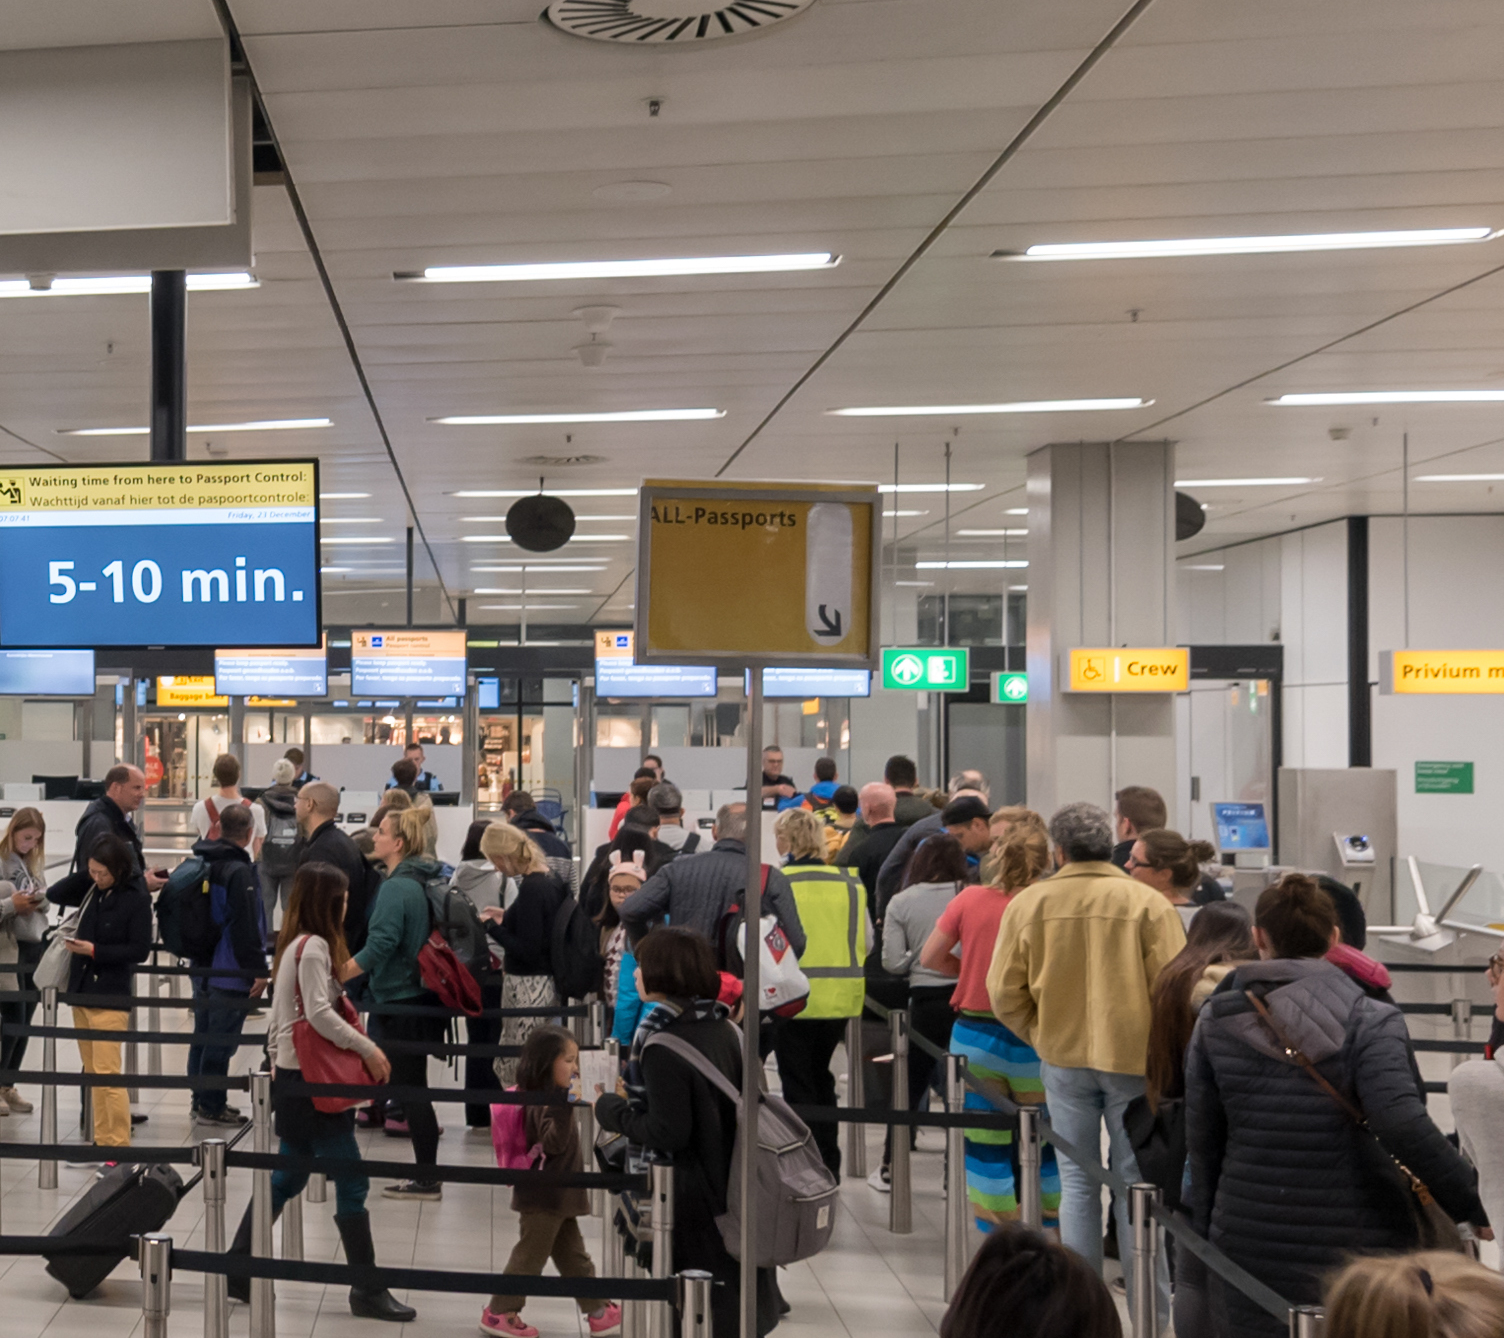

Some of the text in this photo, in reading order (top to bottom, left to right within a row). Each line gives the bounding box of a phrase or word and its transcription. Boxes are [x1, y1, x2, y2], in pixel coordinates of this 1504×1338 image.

[30, 471, 307, 488] Waiting time from here to Passport Control:
[30, 492, 310, 508] Wachttijd vanaf hier tot de paspoortcontrole:
[227, 511, 255, 520] Friday,
[269, 510, 311, 519] December
[650, 506, 796, 530] ALL-Passports
[48, 556, 304, 604] 5-10 min.
[1127, 661, 1178, 677] Crew
[1402, 663, 1481, 679] Privium
[169, 692, 203, 701] Baggage
